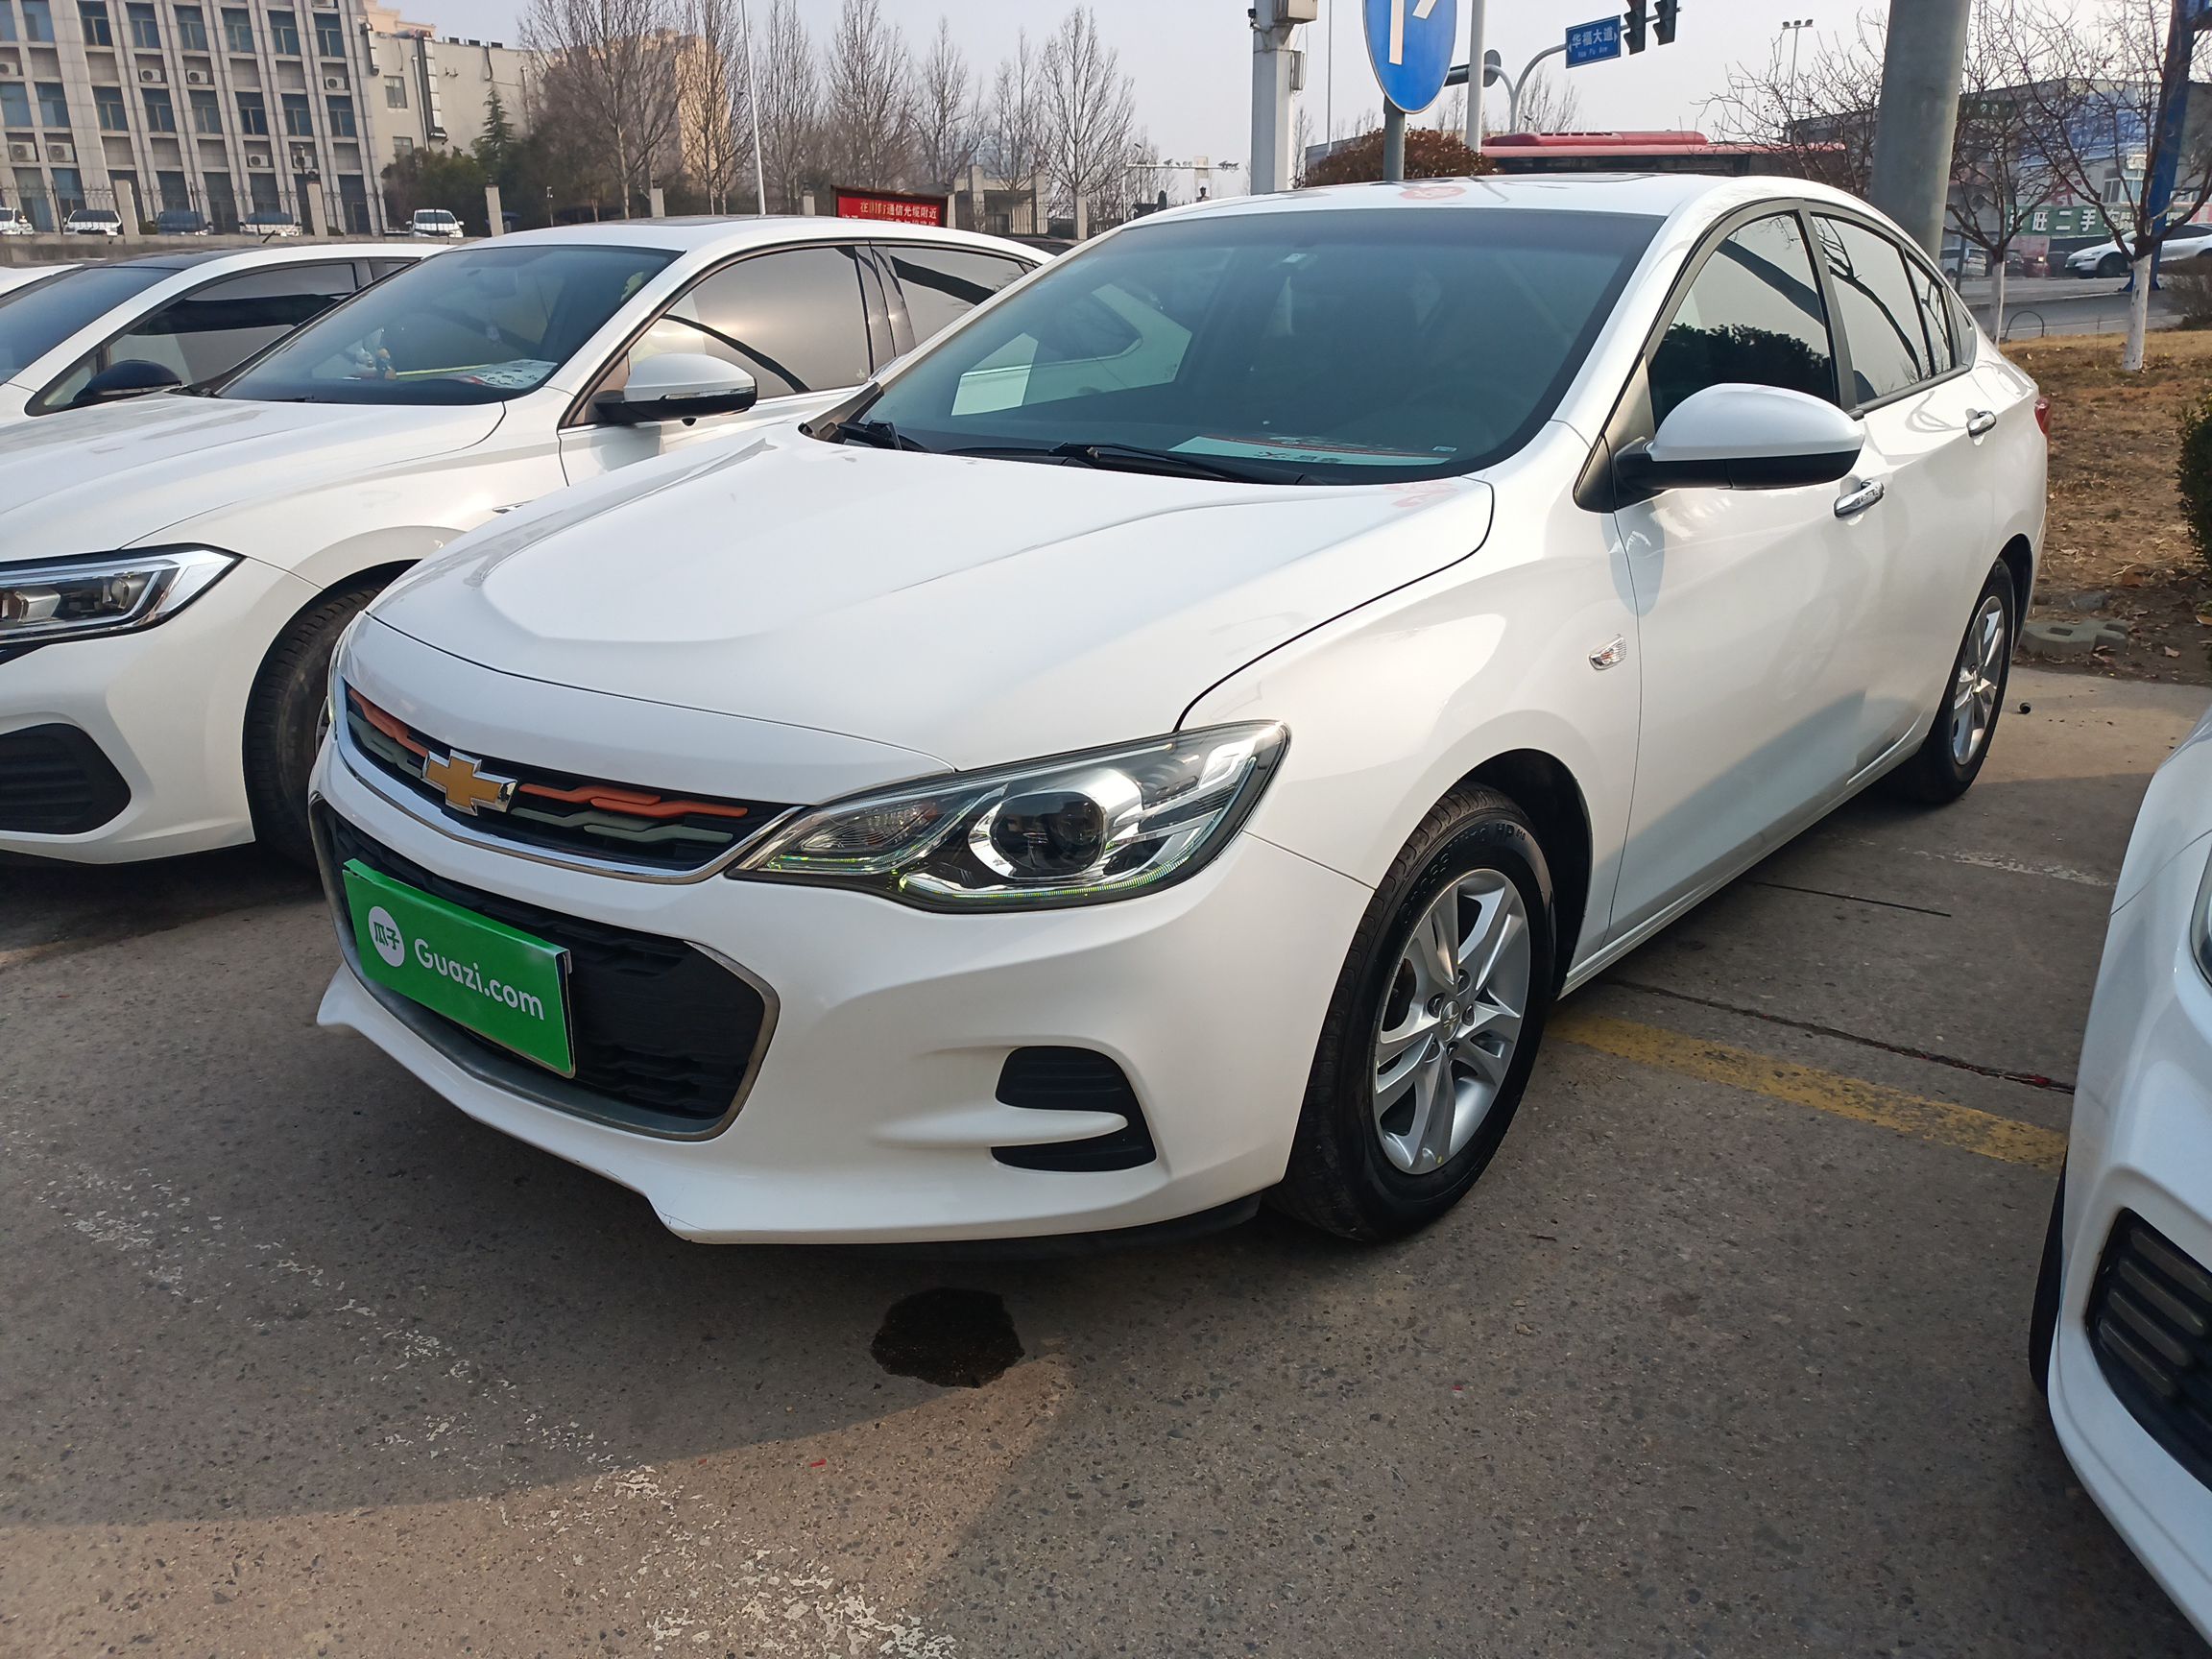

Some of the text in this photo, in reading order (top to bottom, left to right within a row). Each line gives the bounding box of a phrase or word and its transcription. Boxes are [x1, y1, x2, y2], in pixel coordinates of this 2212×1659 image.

[1572, 26, 1614, 48] 华福大道
[373, 921, 400, 950] 瓜子
[414, 938, 544, 1021] Guazi.com
